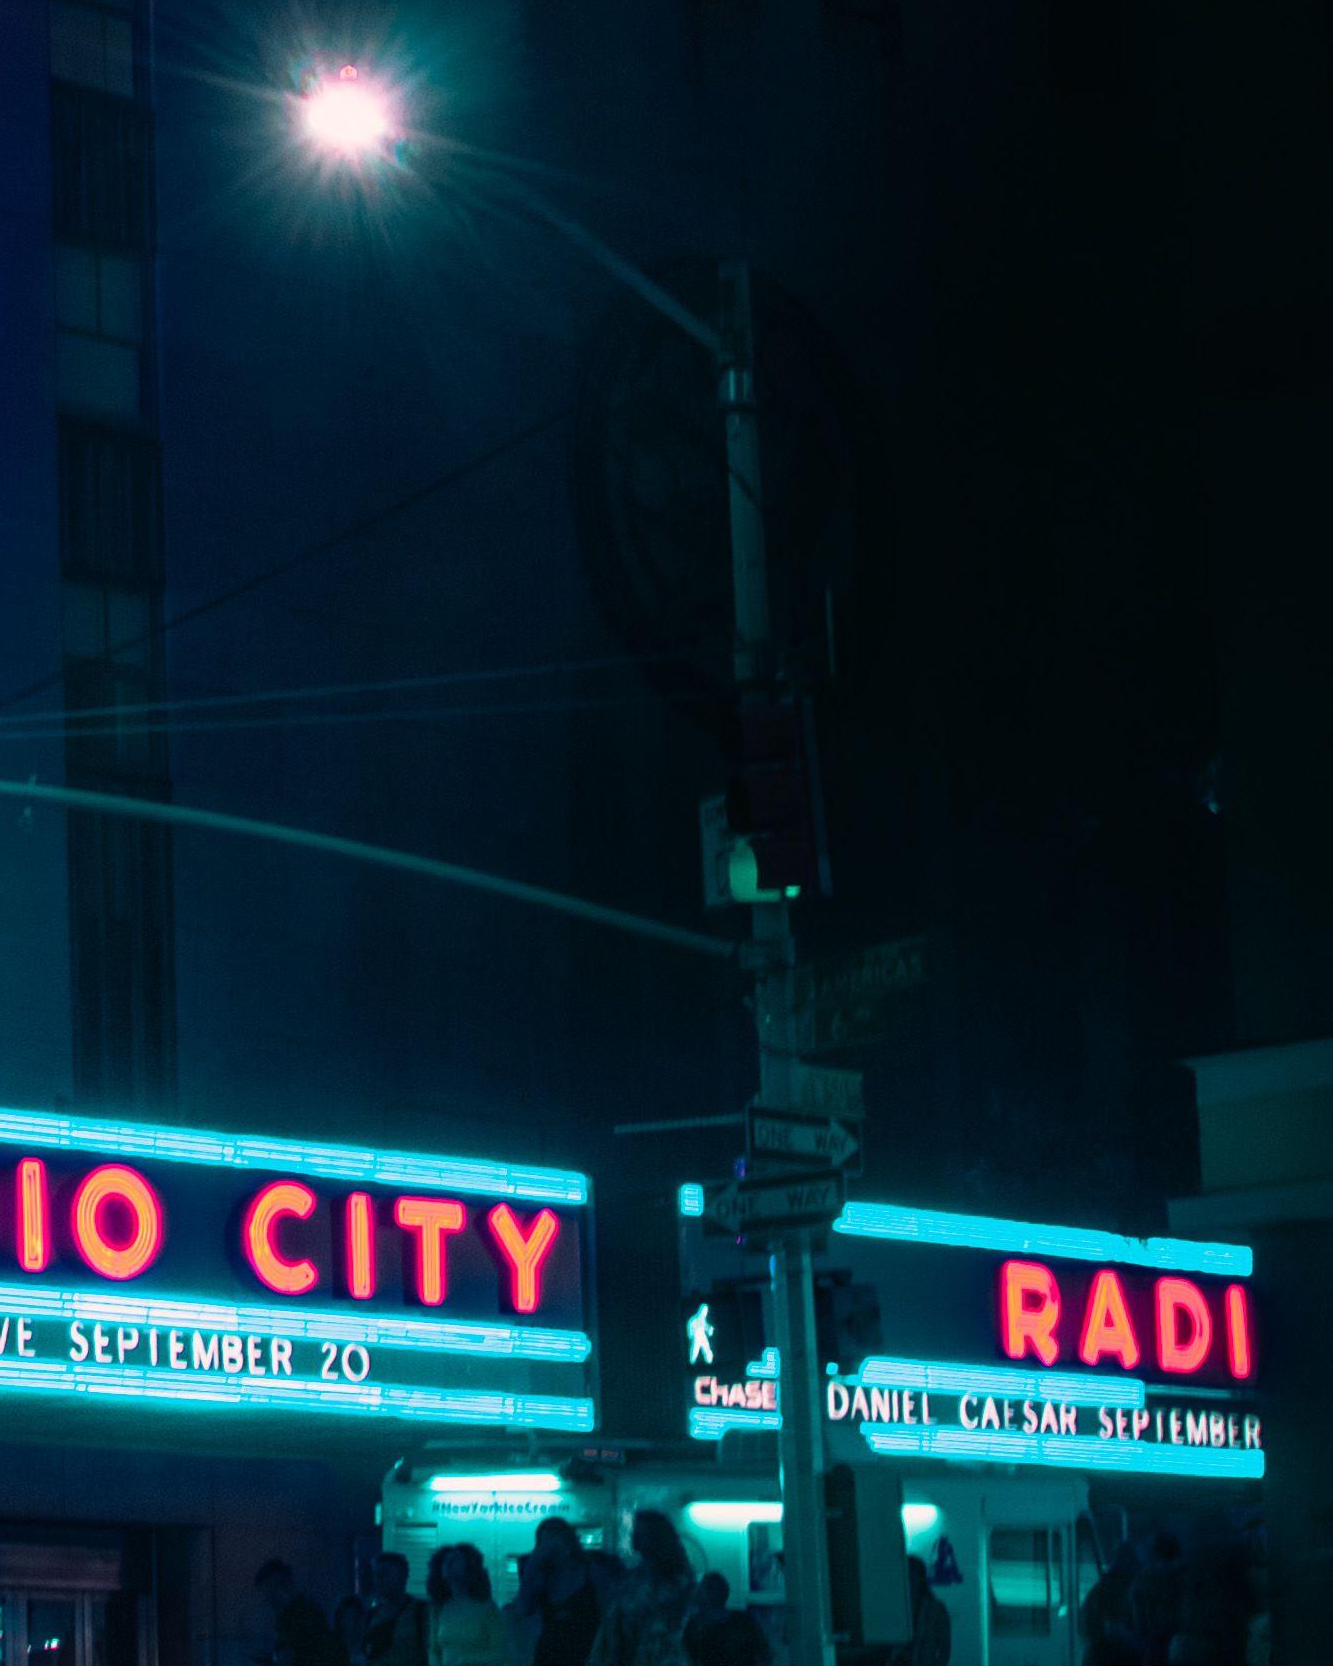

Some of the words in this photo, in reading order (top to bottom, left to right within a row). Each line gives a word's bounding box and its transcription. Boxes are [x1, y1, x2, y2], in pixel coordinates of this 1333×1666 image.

[244, 1180, 560, 1313] CITY
[69, 1321, 294, 1376] SEPTEMBER
[320, 1341, 372, 1383] 20
[1001, 1259, 1251, 1379] RADI
[694, 1375, 778, 1410] CHASE
[826, 1382, 935, 1426] DANIEL
[958, 1391, 1078, 1436] CAESAR
[1099, 1404, 1263, 1450] SEPTEMBER
